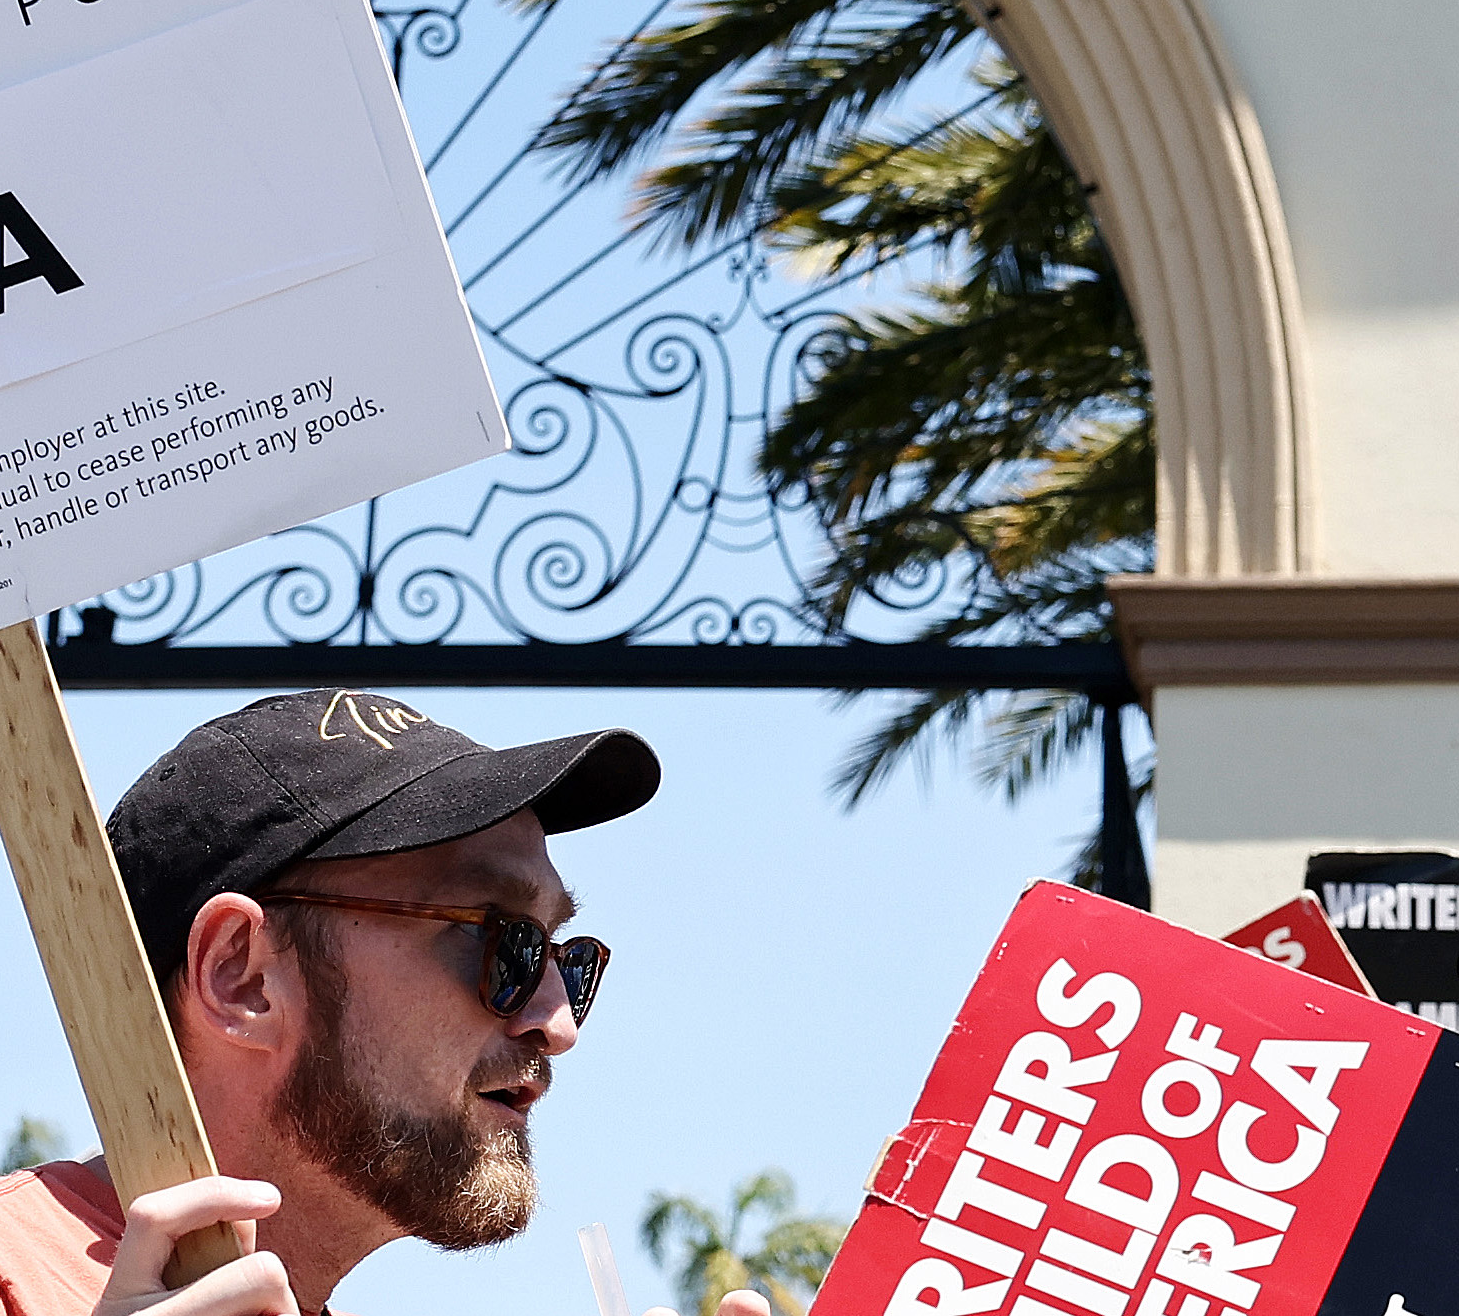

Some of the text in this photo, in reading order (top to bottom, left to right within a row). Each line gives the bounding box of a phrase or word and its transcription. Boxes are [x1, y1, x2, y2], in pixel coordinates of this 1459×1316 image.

[15, 496, 98, 539] handle
[106, 486, 128, 508] or
[136, 442, 251, 497] transport
[256, 427, 296, 455] any
[306, 397, 384, 444] goods.
[44, 472, 70, 492] to
[78, 446, 144, 480] cease
[151, 395, 287, 462] performing
[292, 377, 331, 405] any
[94, 414, 118, 438] at
[123, 398, 168, 427] this
[175, 382, 225, 409] site.
[1141, 1011, 1241, 1140] OF
